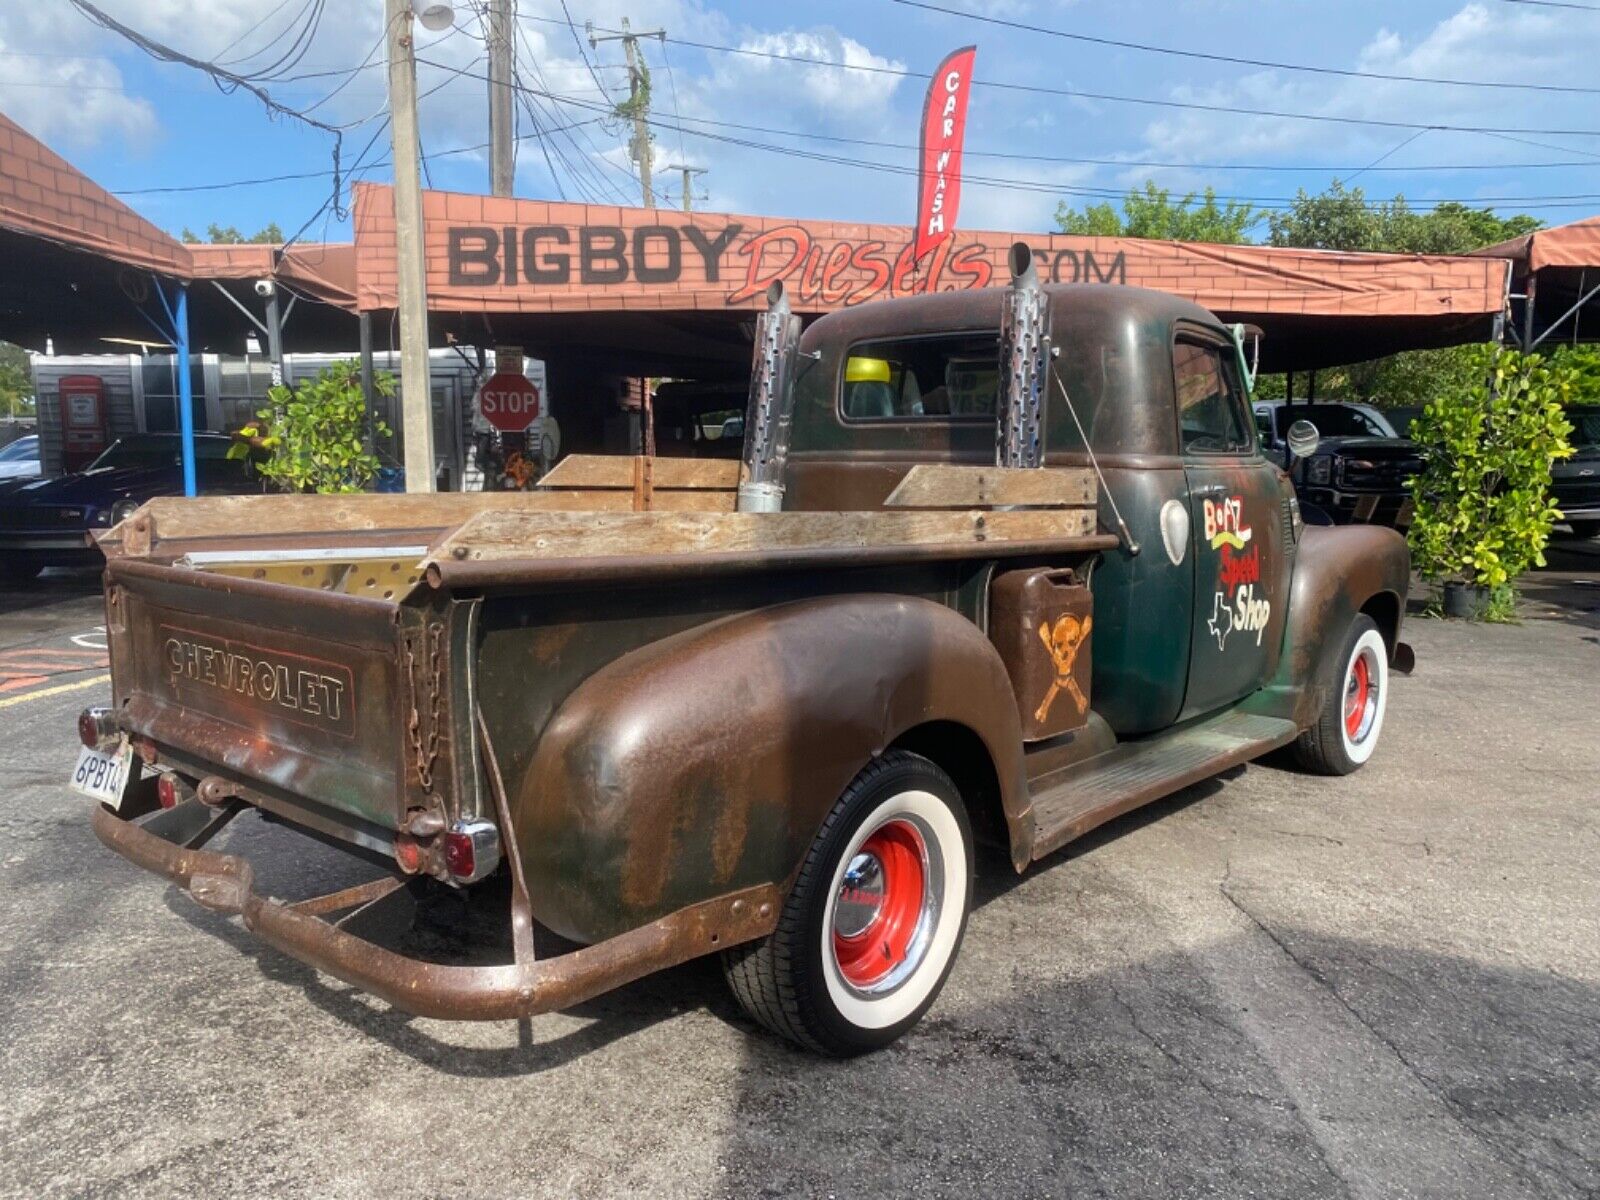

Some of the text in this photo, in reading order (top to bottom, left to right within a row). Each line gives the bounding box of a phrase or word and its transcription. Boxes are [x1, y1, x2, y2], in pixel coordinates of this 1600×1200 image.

[928, 71, 960, 236] CAR WASH
[447, 224, 743, 287] BIGBOY
[483, 391, 536, 413] STOP
[1233, 583, 1271, 646] Shop
[166, 637, 345, 721] CHEVROLET
